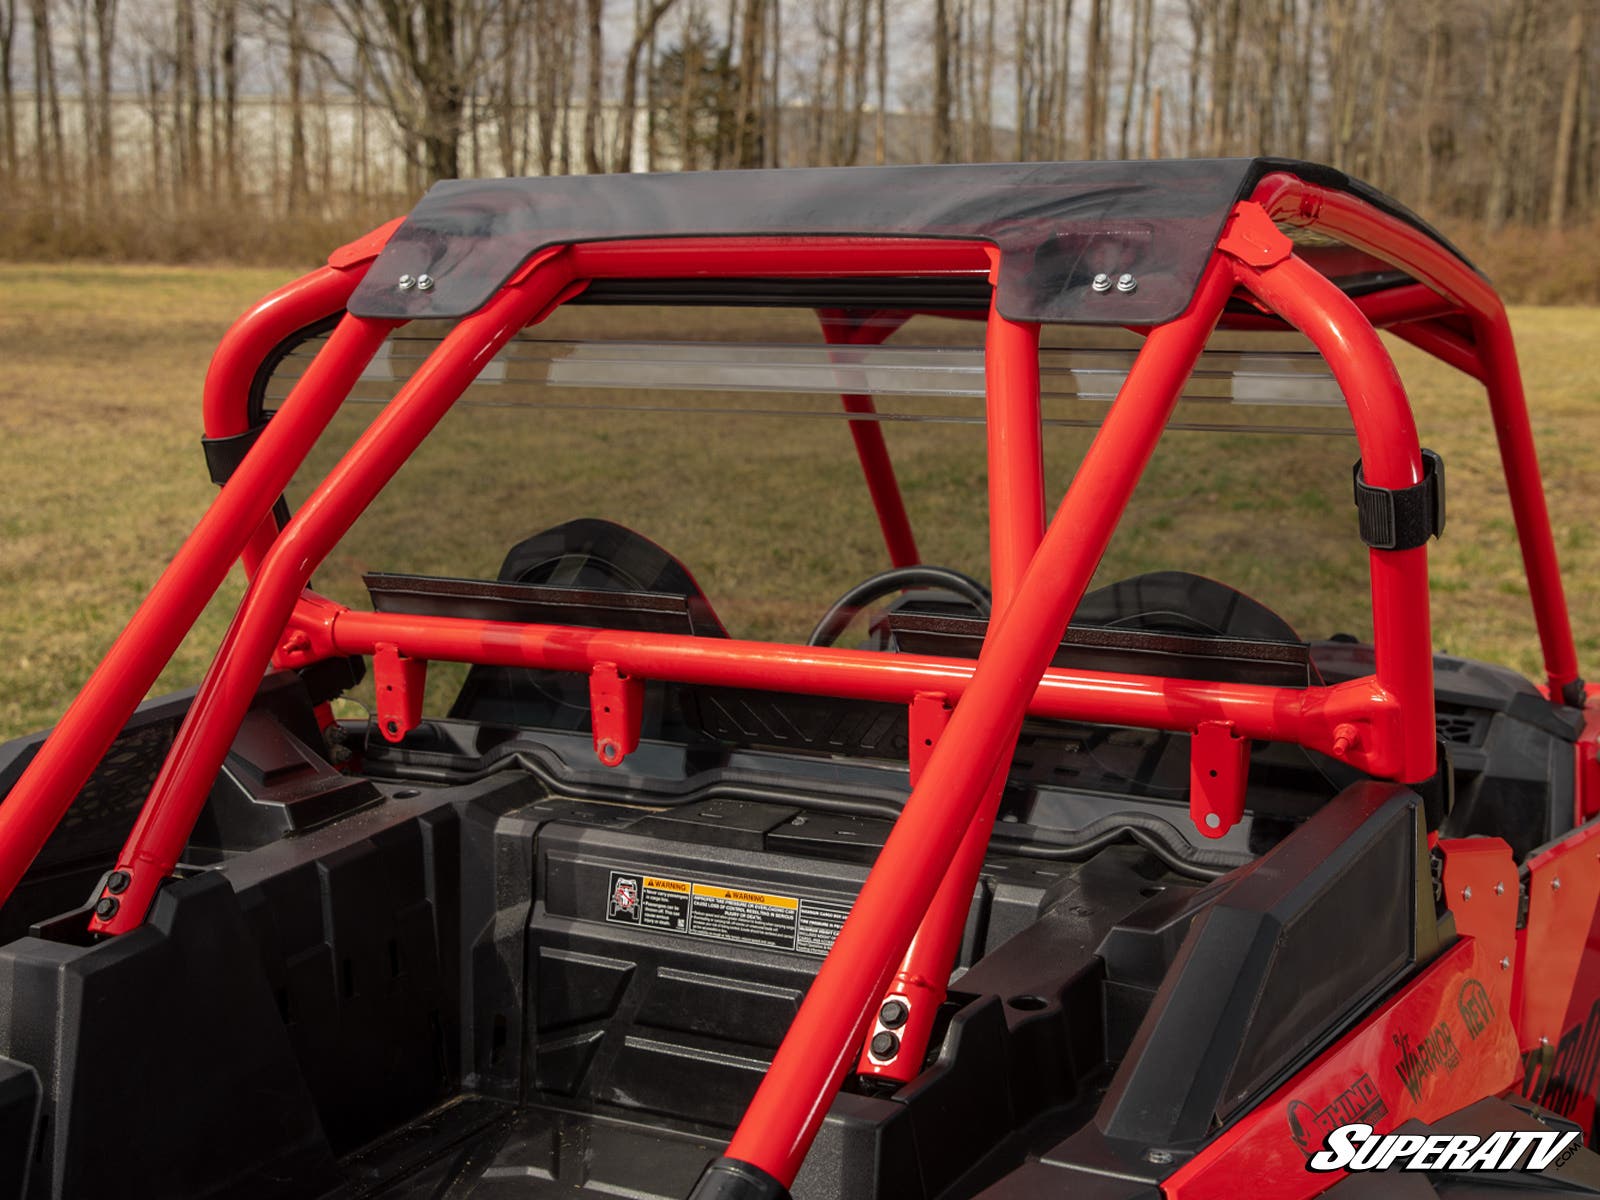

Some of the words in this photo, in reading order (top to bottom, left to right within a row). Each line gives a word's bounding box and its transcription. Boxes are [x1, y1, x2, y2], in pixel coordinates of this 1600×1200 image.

[654, 880, 686, 892] WARNING
[732, 892, 765, 903] WARNING
[1395, 1022, 1462, 1104] WARRIOR
